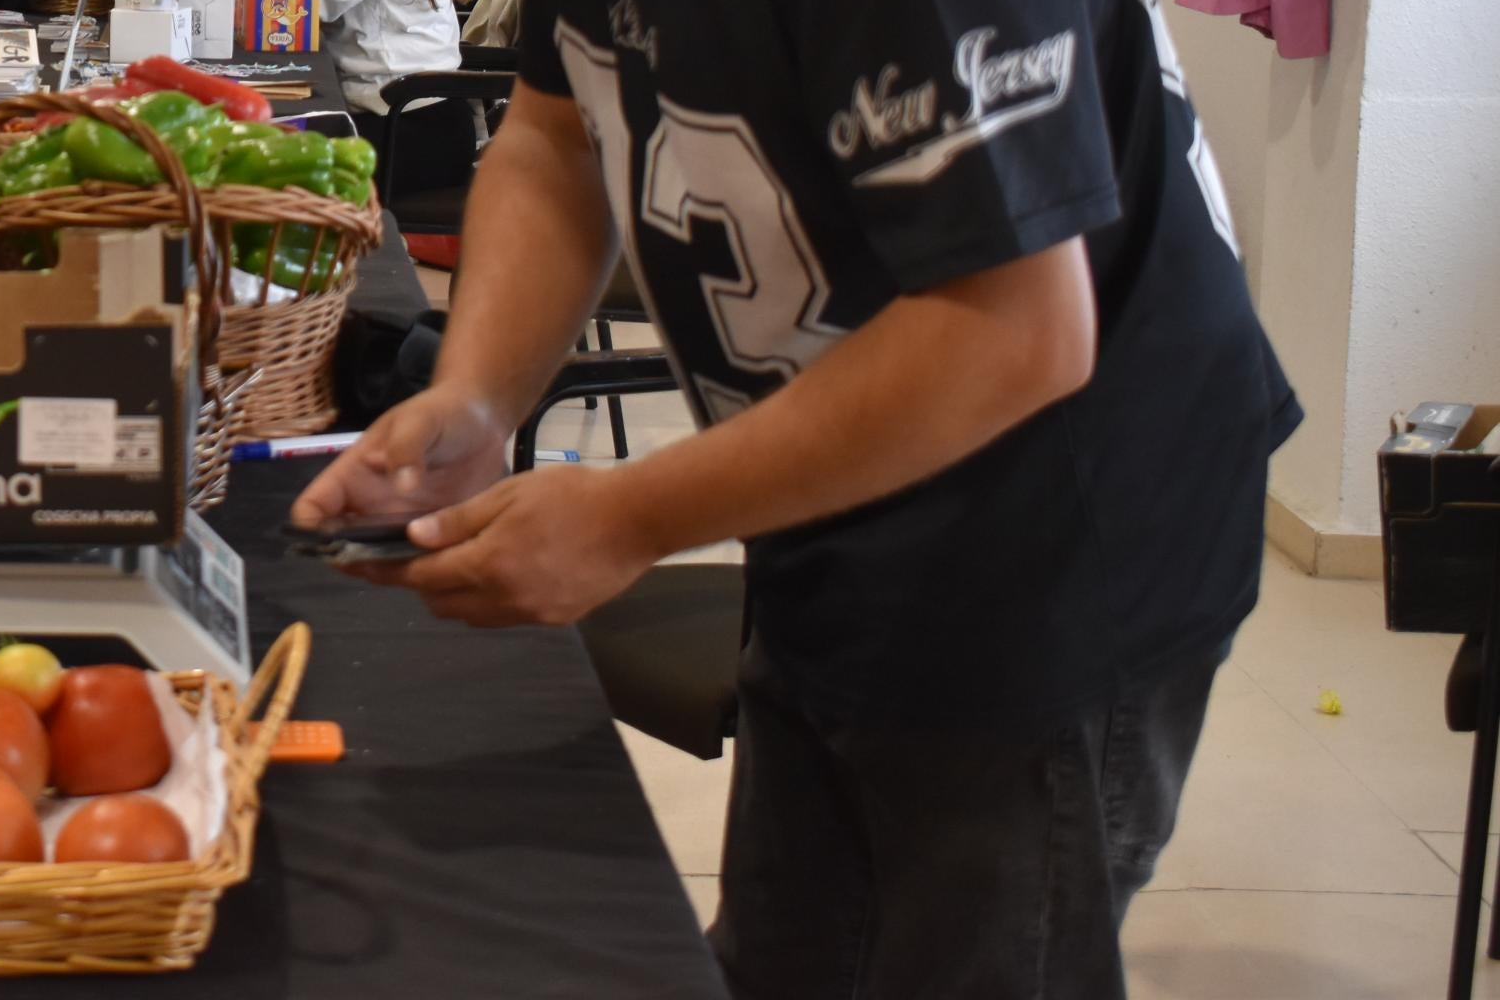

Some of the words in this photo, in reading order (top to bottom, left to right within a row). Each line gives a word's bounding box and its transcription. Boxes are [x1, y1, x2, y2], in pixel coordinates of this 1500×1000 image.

[941, 24, 1077, 132] Jersey
[32, 509, 100, 526] COSECHA
[102, 509, 158, 525] PROPIA
